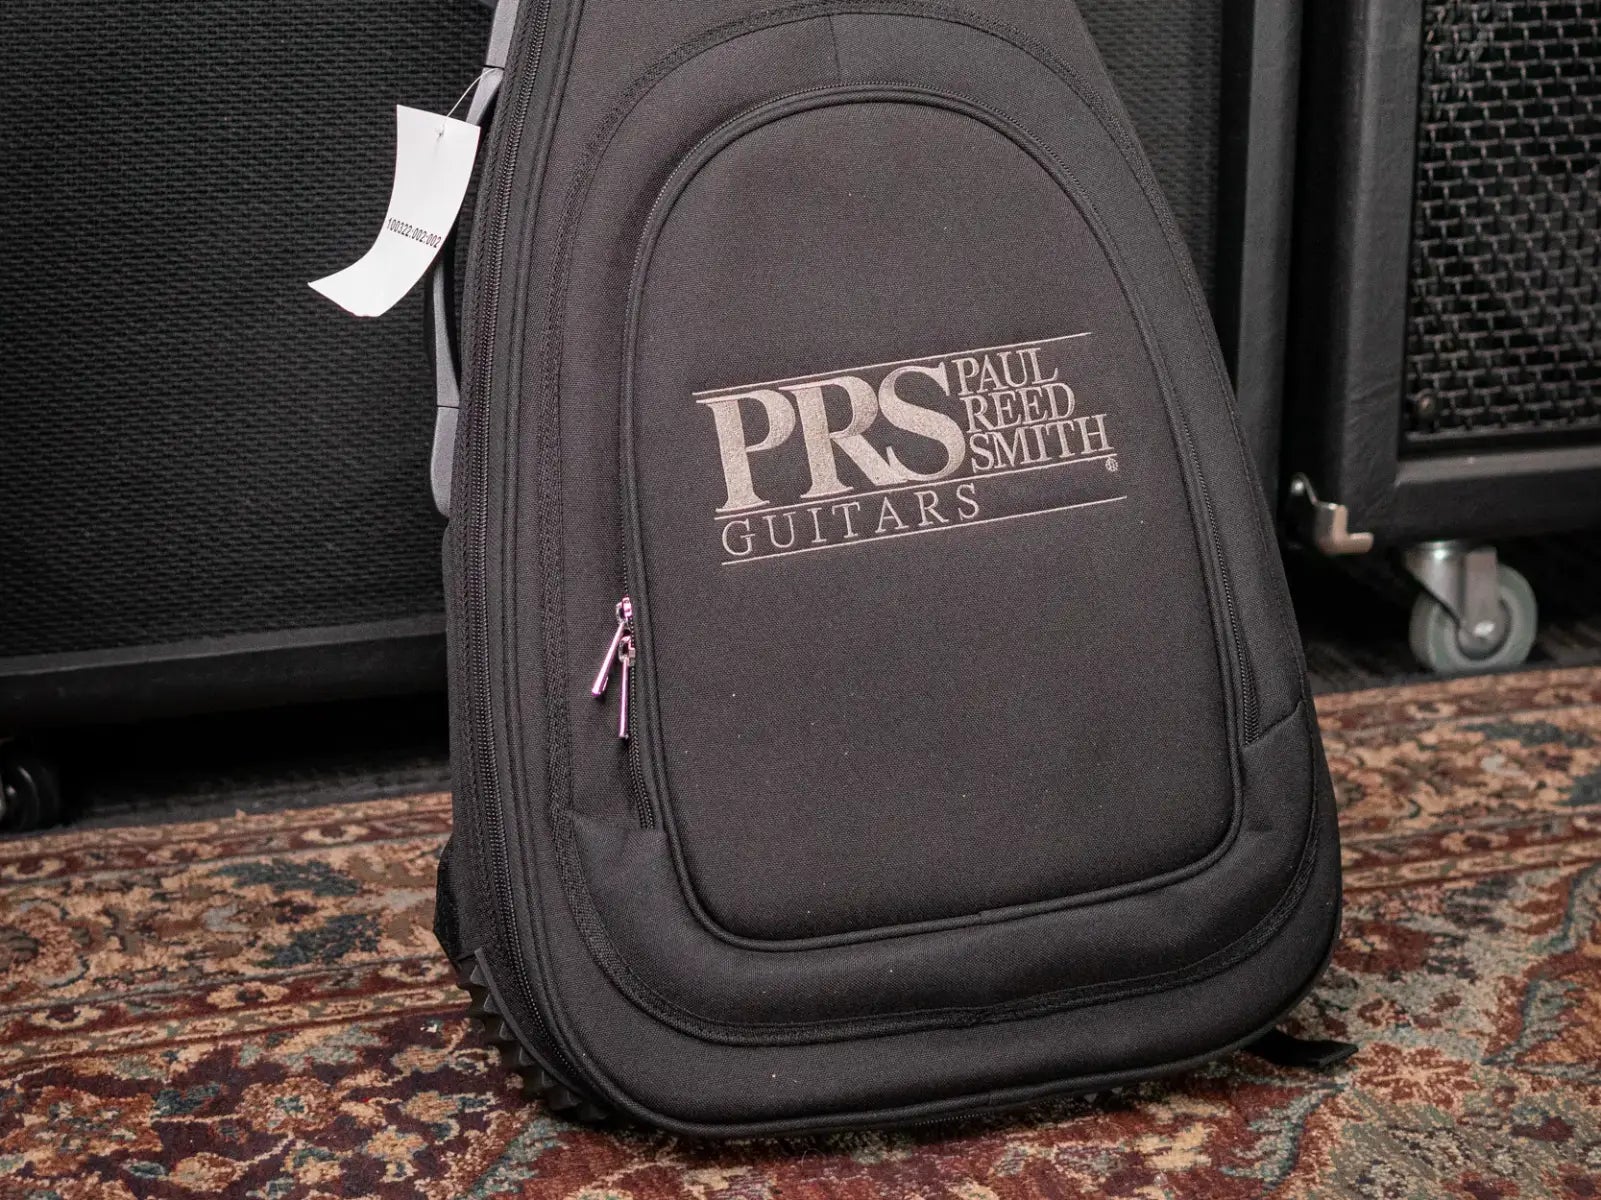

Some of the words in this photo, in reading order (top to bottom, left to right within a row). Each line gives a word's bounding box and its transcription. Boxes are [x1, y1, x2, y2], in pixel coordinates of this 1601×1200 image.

[952, 348, 1059, 396] PAUL
[959, 382, 1076, 433] REED
[696, 362, 966, 513] PRS
[969, 414, 1115, 473] SMITH
[721, 482, 980, 556] GUITARS
